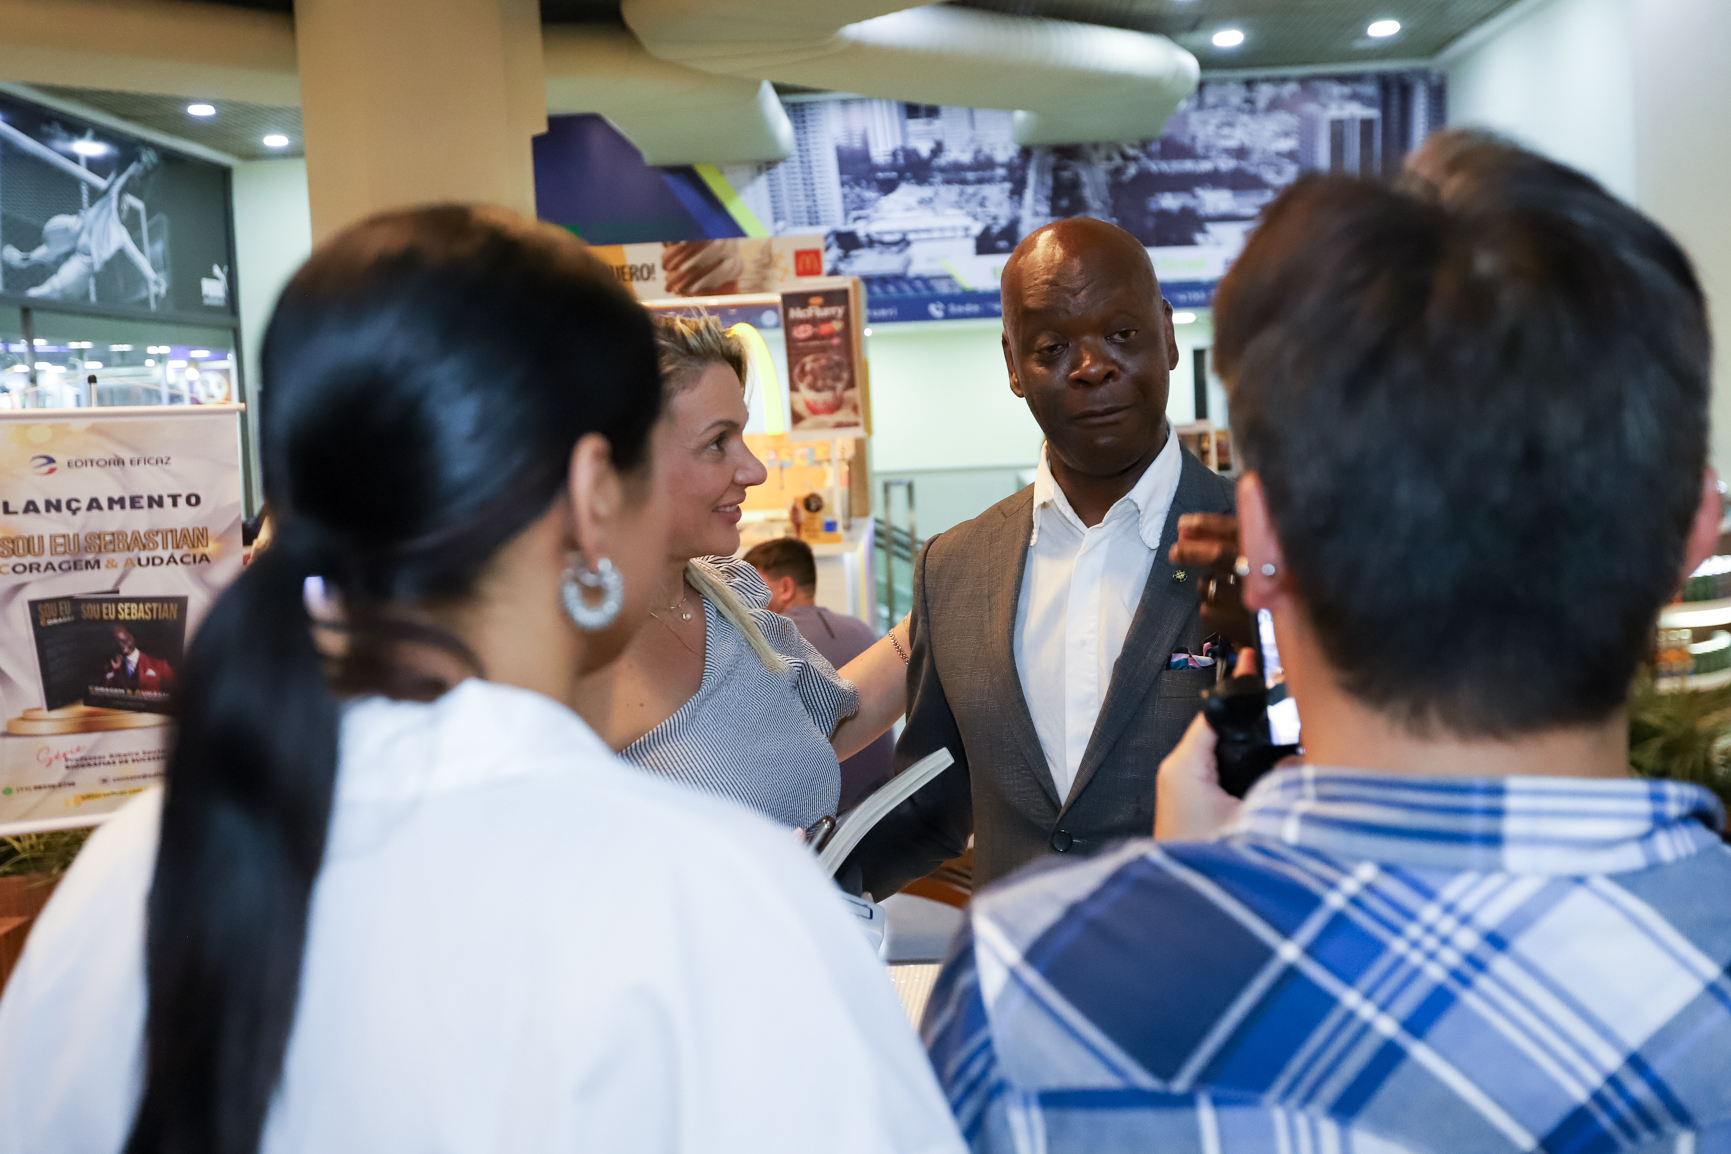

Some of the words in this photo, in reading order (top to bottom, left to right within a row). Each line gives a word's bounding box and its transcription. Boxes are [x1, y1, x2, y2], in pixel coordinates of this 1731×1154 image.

[67, 457, 125, 469] EDITORA
[130, 456, 172, 467] EFICAZ
[2, 492, 202, 515] LANÇAMENTO
[0, 533, 44, 559] SOU
[50, 531, 80, 556] EU
[84, 526, 209, 554] SEBASTIAN
[0, 559, 101, 575] CORAGEM
[105, 558, 118, 570] &
[124, 553, 211, 568] AUDÁCIA
[81, 602, 99, 620] SOU
[102, 602, 116, 620] EU
[118, 602, 177, 620] SEBASTIAN
